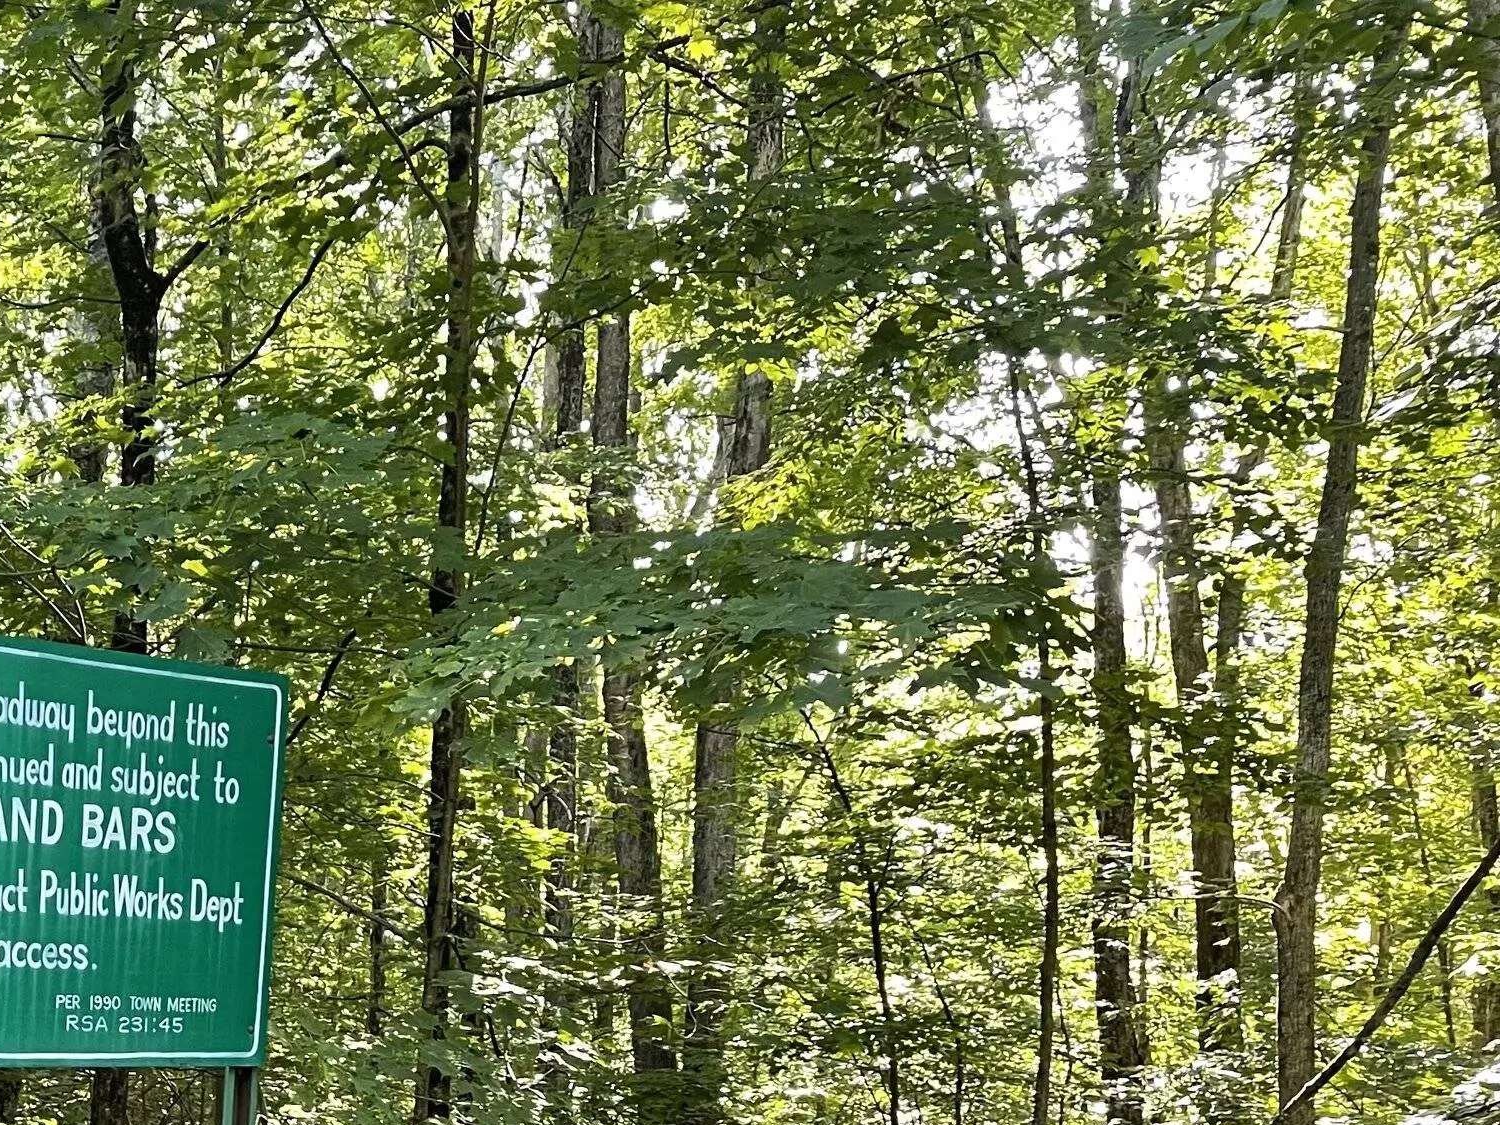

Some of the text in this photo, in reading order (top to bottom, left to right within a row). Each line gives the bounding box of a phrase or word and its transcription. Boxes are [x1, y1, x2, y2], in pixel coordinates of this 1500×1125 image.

[86, 689, 176, 749] beyond
[186, 702, 230, 748] this
[61, 748, 103, 791] and
[110, 752, 200, 806] subject
[214, 760, 240, 804] to
[81, 803, 177, 854] BARS
[39, 869, 110, 917] Public
[113, 873, 184, 921] Works
[189, 878, 244, 933] Dept
[55, 994, 218, 1013] PER 1990 TOWN MEETING
[65, 1014, 184, 1034] RSA 231:45
